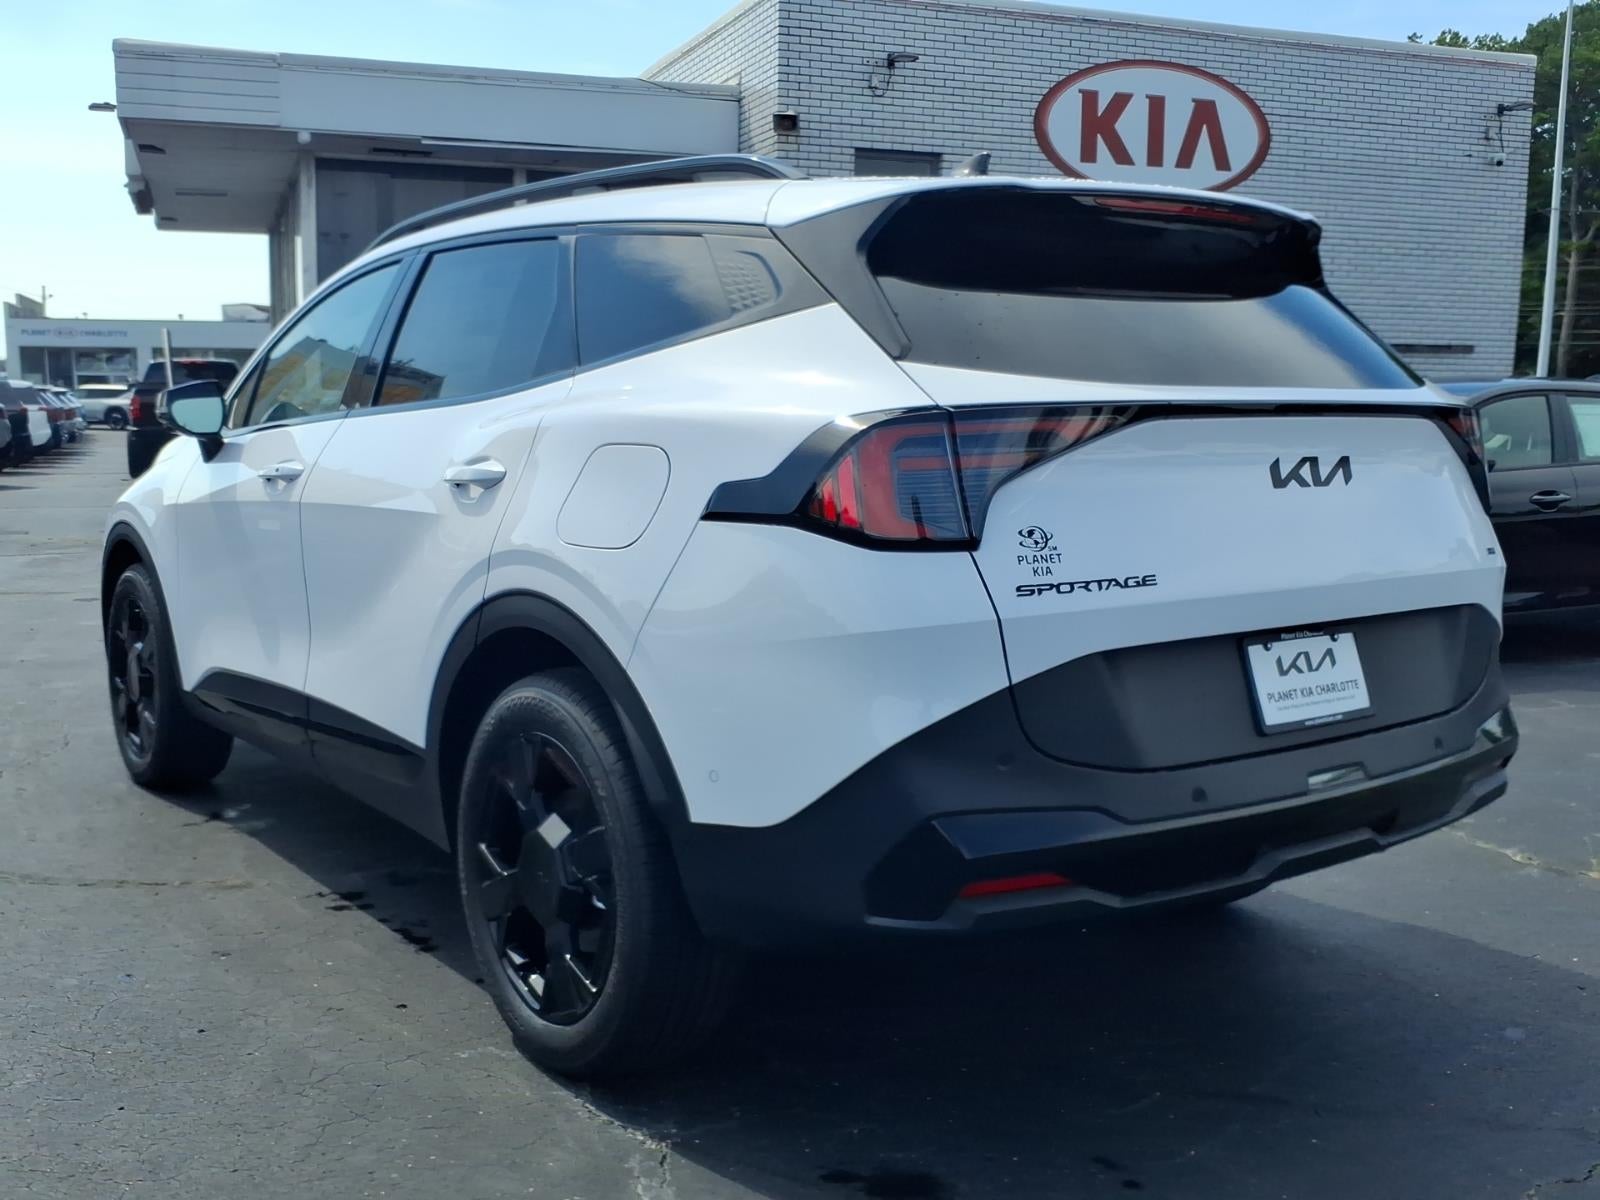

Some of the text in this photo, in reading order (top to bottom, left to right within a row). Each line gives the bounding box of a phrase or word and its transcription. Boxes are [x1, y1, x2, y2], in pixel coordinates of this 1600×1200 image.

[1078, 89, 1231, 171] KIA
[1269, 455, 1353, 489] KIA
[1017, 553, 1062, 565] PLANET
[1032, 566, 1053, 577] KIA
[1016, 574, 1158, 598] SPORTAGE
[1275, 647, 1337, 677] KIA
[1267, 689, 1299, 704] PLANET
[1300, 686, 1314, 698] KIA
[1315, 679, 1360, 696] CHARLOTTE
